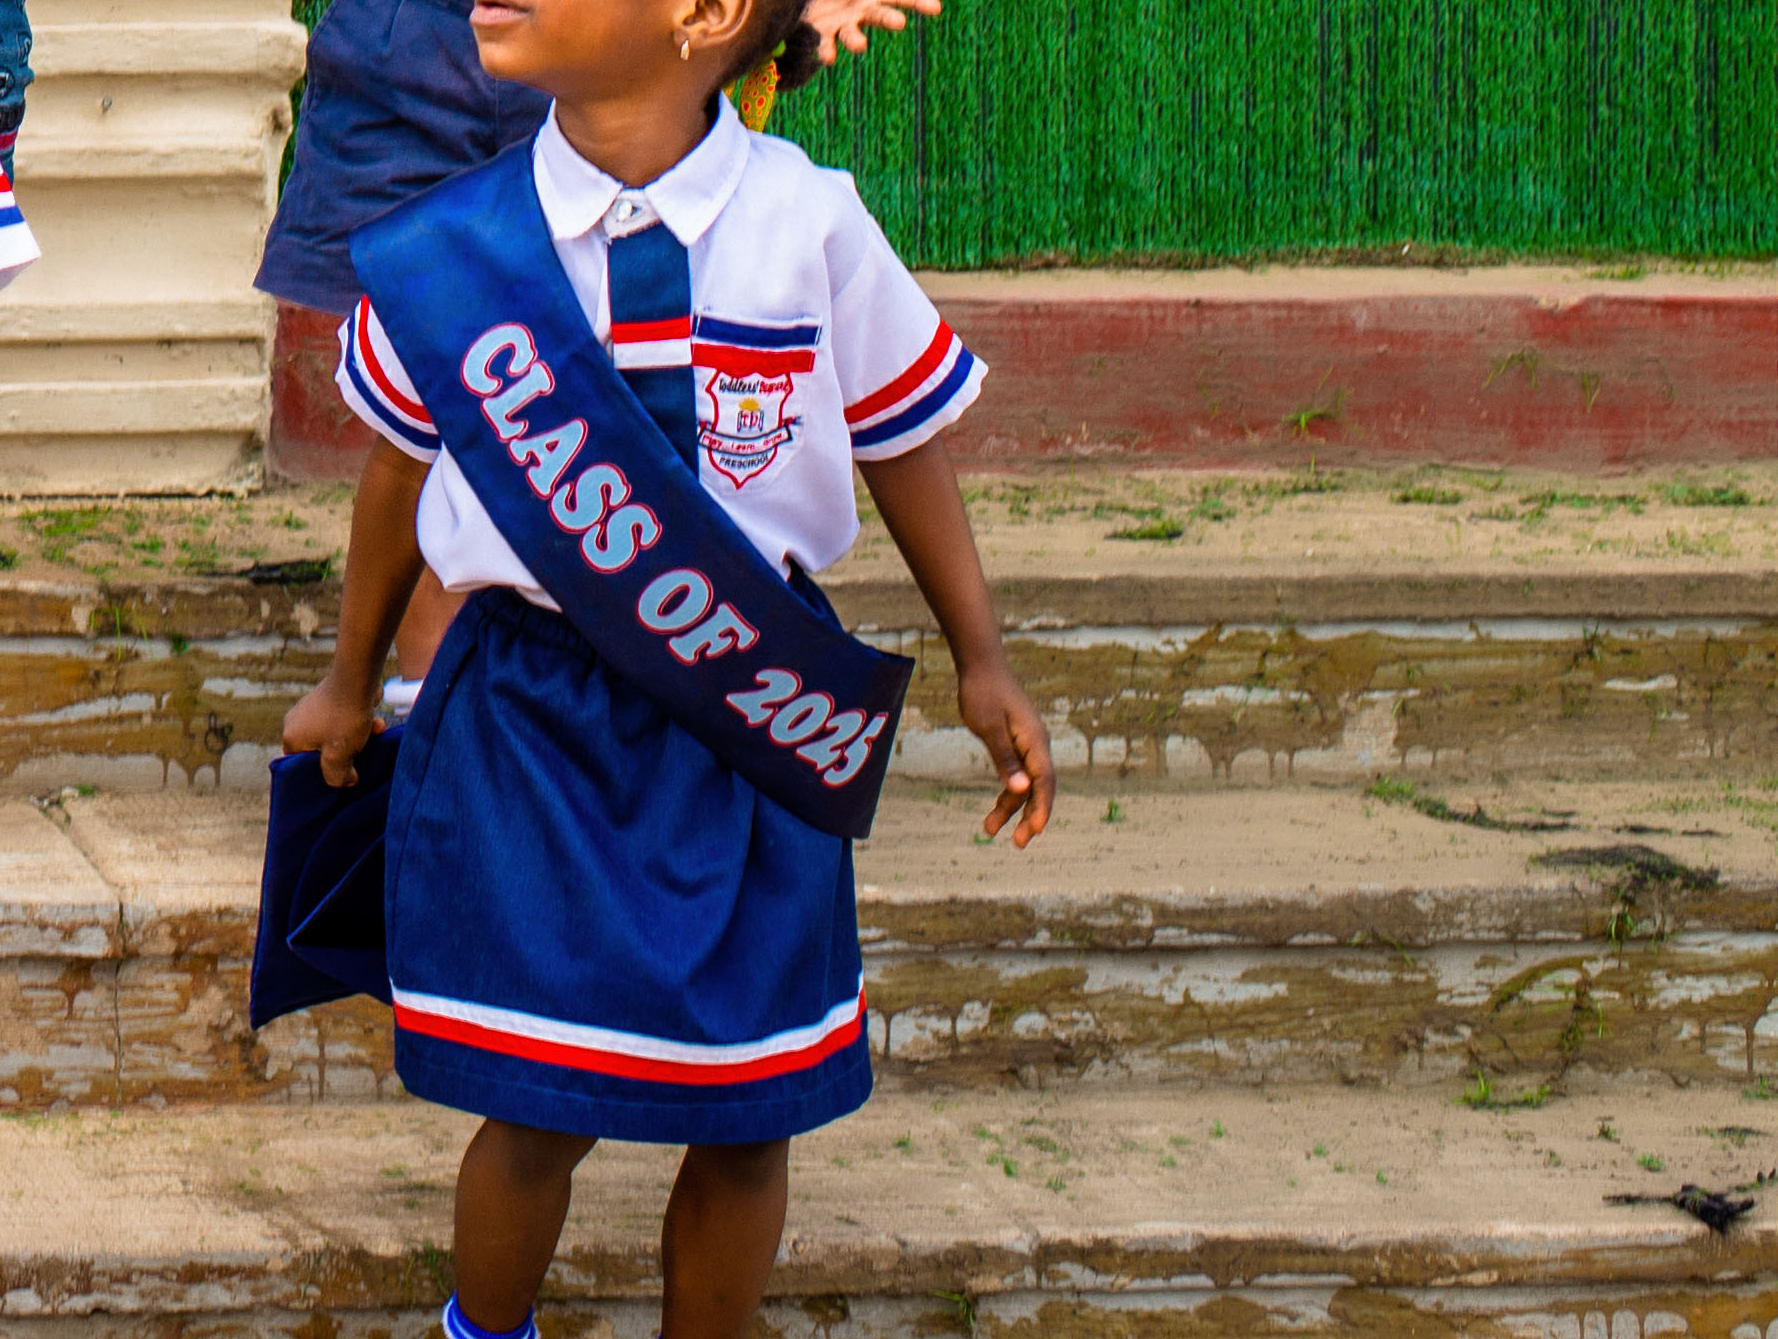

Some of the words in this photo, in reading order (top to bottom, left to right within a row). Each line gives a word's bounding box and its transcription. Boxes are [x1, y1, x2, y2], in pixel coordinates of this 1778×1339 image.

[460, 322, 662, 574] CLASS
[636, 567, 759, 666] OF
[725, 668, 888, 788] 2025
